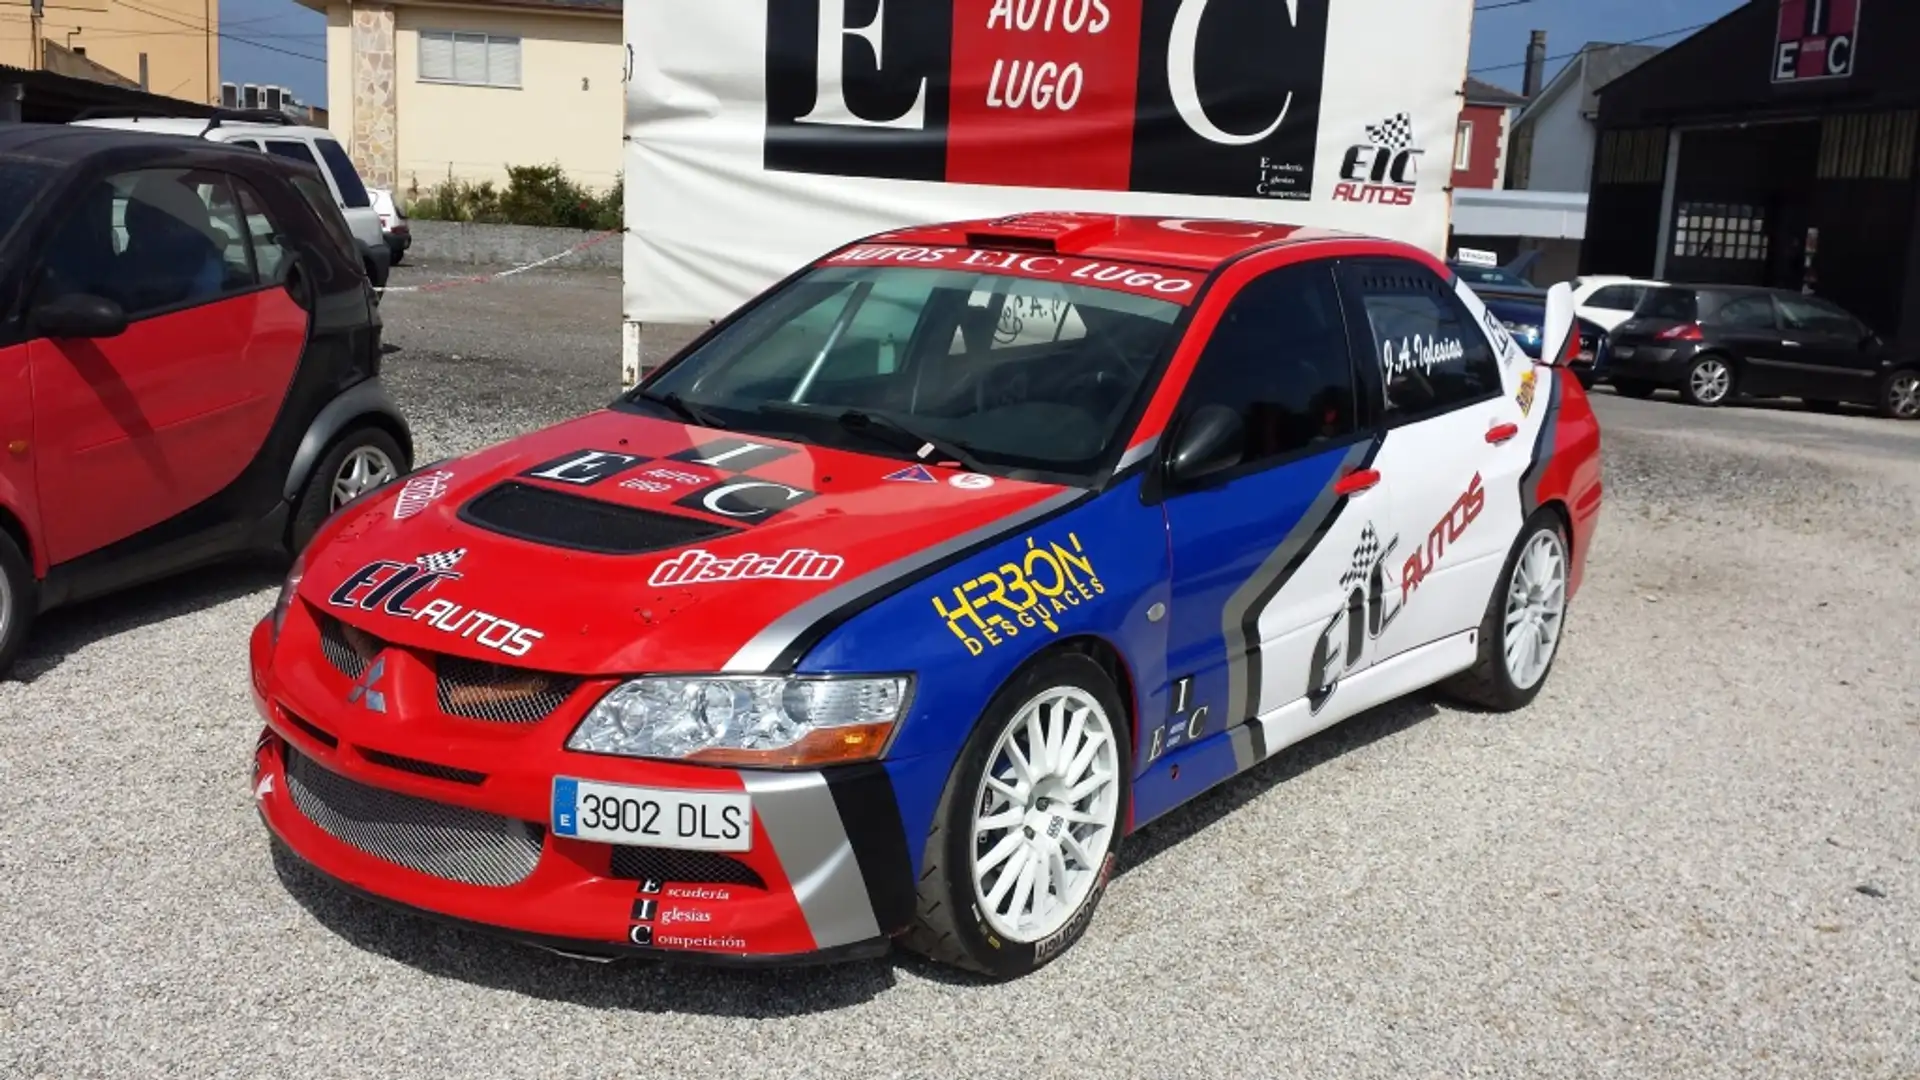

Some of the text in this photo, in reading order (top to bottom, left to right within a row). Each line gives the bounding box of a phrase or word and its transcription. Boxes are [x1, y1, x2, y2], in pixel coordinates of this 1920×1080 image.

[986, 0, 1110, 33] AUTOS
[794, 0, 927, 130] E
[1167, 0, 1298, 145] C
[1777, 41, 1798, 78] E
[1827, 36, 1849, 73] C
[986, 59, 1083, 111] LUGO
[1339, 145, 1425, 186] EIC
[1332, 184, 1415, 205] AUTOS
[829, 247, 1193, 294] AUTOS EIC LUGO
[530, 451, 635, 482] E
[691, 443, 773, 466] I
[703, 482, 804, 516] C
[1401, 470, 1485, 605] AUTOS
[648, 549, 844, 586] disiclin
[329, 560, 544, 656] EIC AUTOS
[963, 577, 1105, 656] DESGUACES
[1176, 679, 1188, 713] I
[1188, 706, 1208, 739] C
[1148, 724, 1165, 762] E
[560, 794, 741, 840] E 3902 DLS
[661, 907, 711, 924] glesias
[658, 935, 746, 949] ompetición
